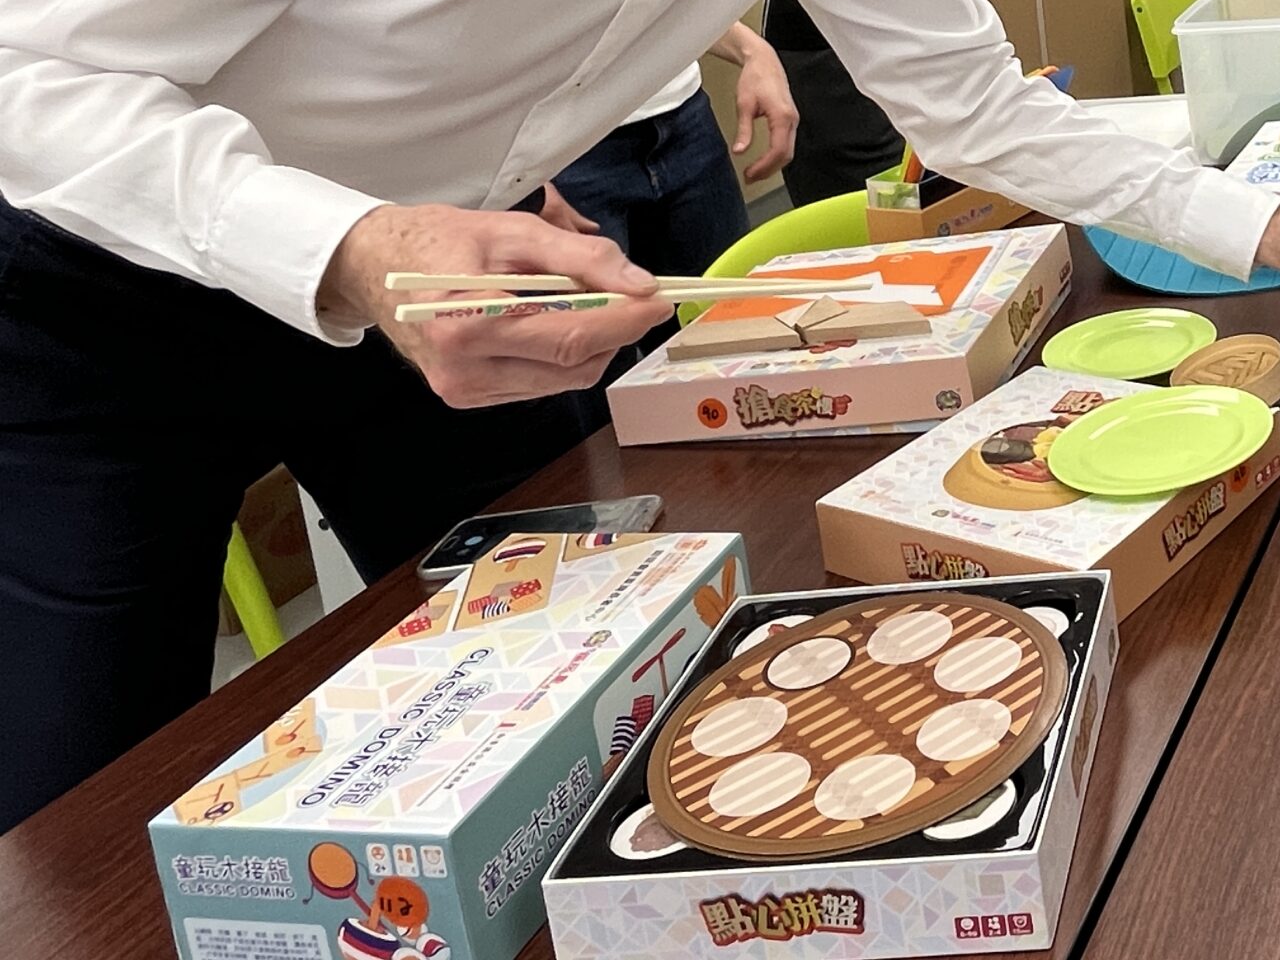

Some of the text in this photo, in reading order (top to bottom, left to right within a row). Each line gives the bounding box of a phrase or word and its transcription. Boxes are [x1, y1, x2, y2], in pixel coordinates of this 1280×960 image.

[1163, 481, 1226, 558] 點心拼盤
[402, 648, 490, 720] CLASSIC
[302, 727, 400, 806] DOMINO
[334, 683, 489, 806] 童玩木接龍
[480, 756, 593, 898] 童玩木接龍
[486, 789, 597, 917] CLASSIC DOMINO
[173, 855, 292, 882] 童玩木接龍
[178, 883, 296, 900] CLASSIC DOMINO
[701, 891, 862, 942] 點心拼盤
